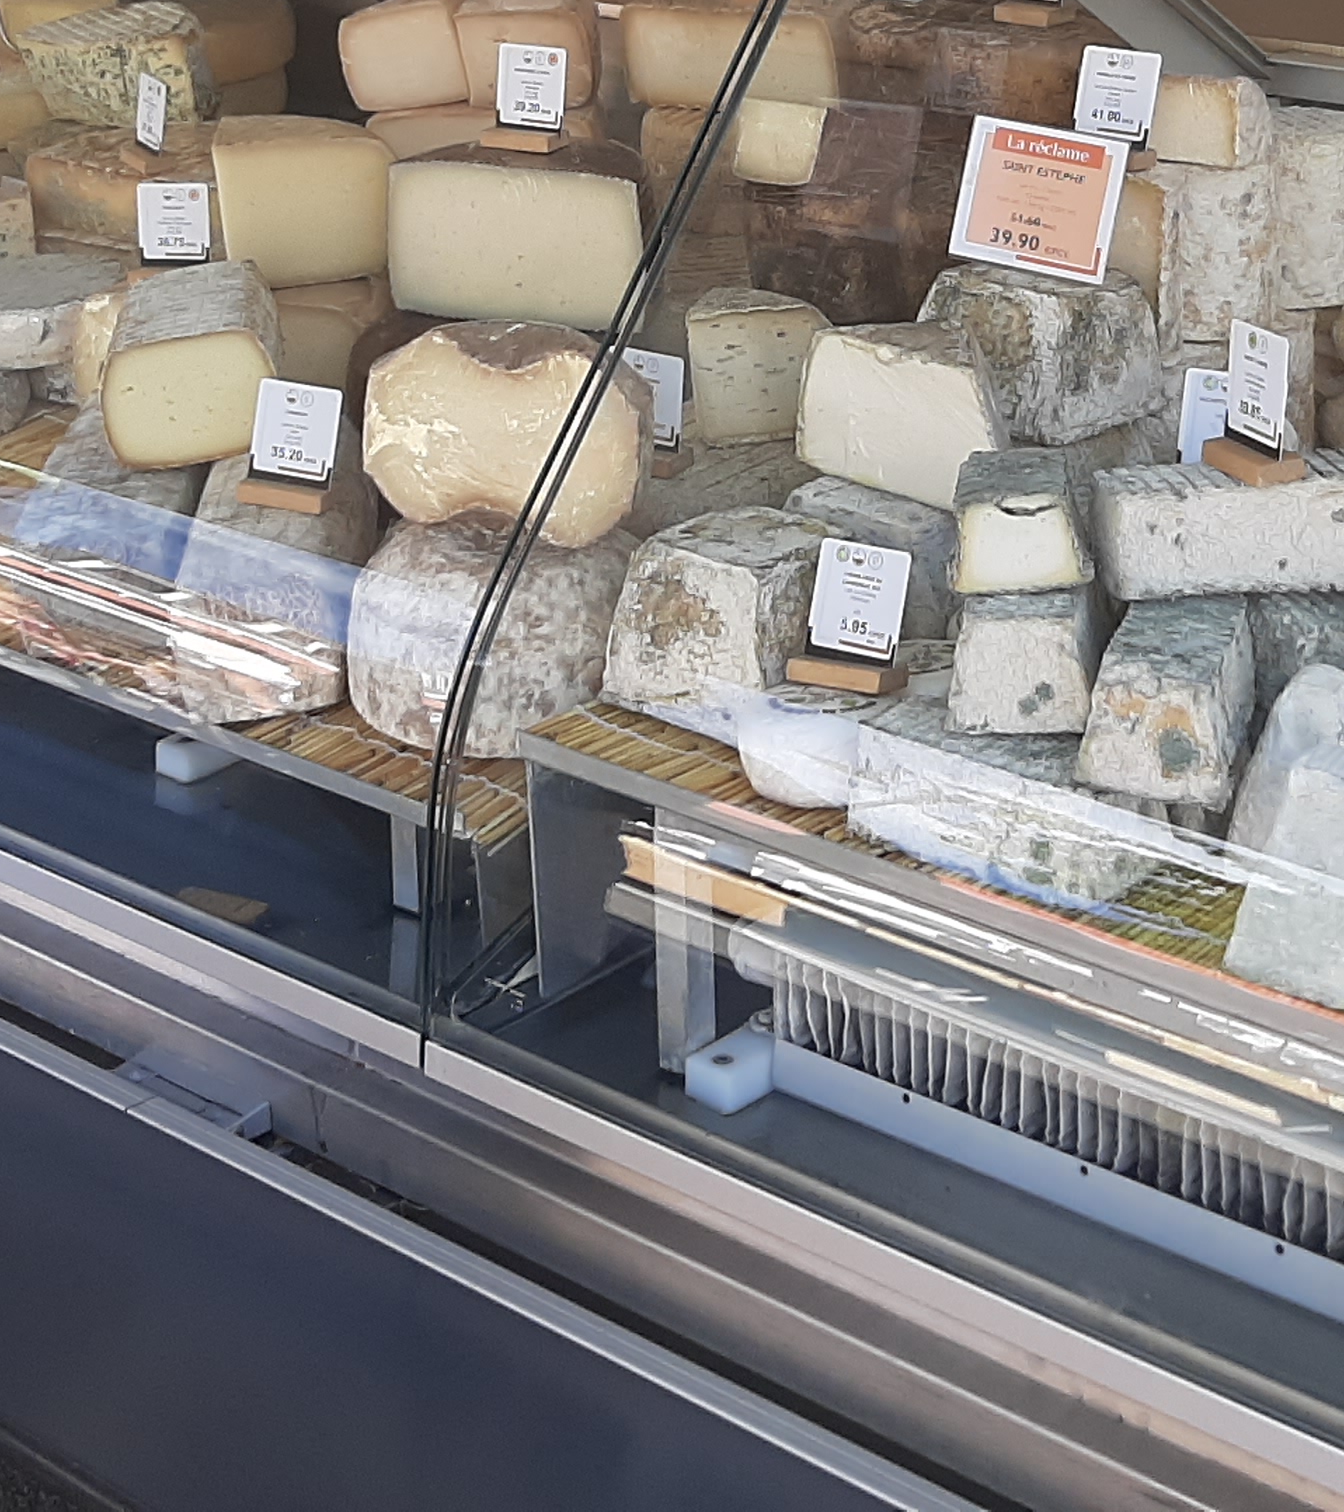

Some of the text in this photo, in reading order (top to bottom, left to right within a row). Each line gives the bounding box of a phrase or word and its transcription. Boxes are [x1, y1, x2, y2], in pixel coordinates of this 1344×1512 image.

[1007, 134, 1091, 164] La réclame
[989, 227, 1041, 252] 39.90
[271, 445, 304, 462] 35.20
